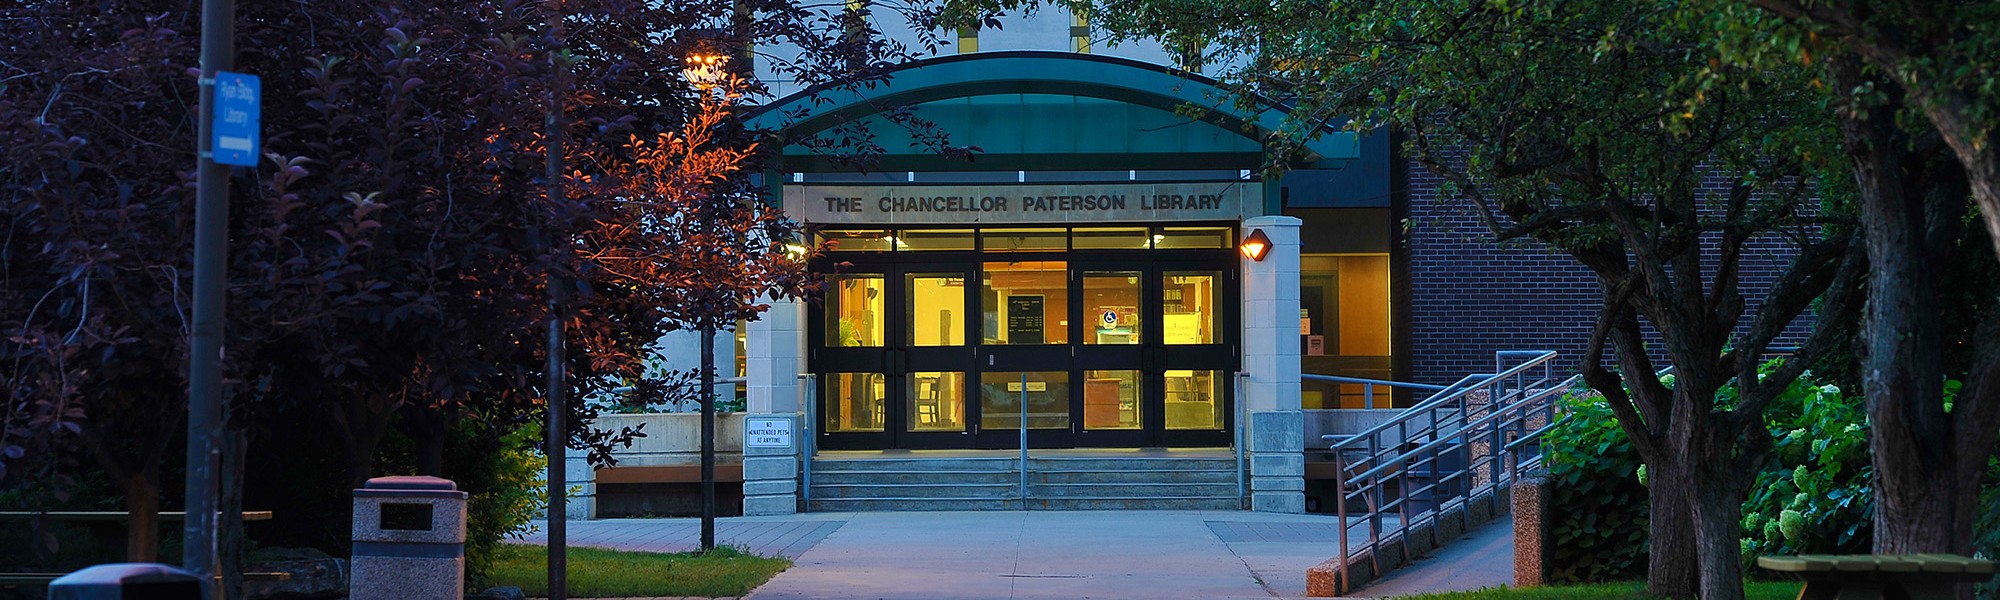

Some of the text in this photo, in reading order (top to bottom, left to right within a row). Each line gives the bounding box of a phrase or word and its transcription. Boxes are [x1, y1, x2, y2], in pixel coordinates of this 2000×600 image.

[223, 106, 247, 128] Library
[824, 194, 1223, 213] THE CHANCELLOR PATERSON LIBRARY
